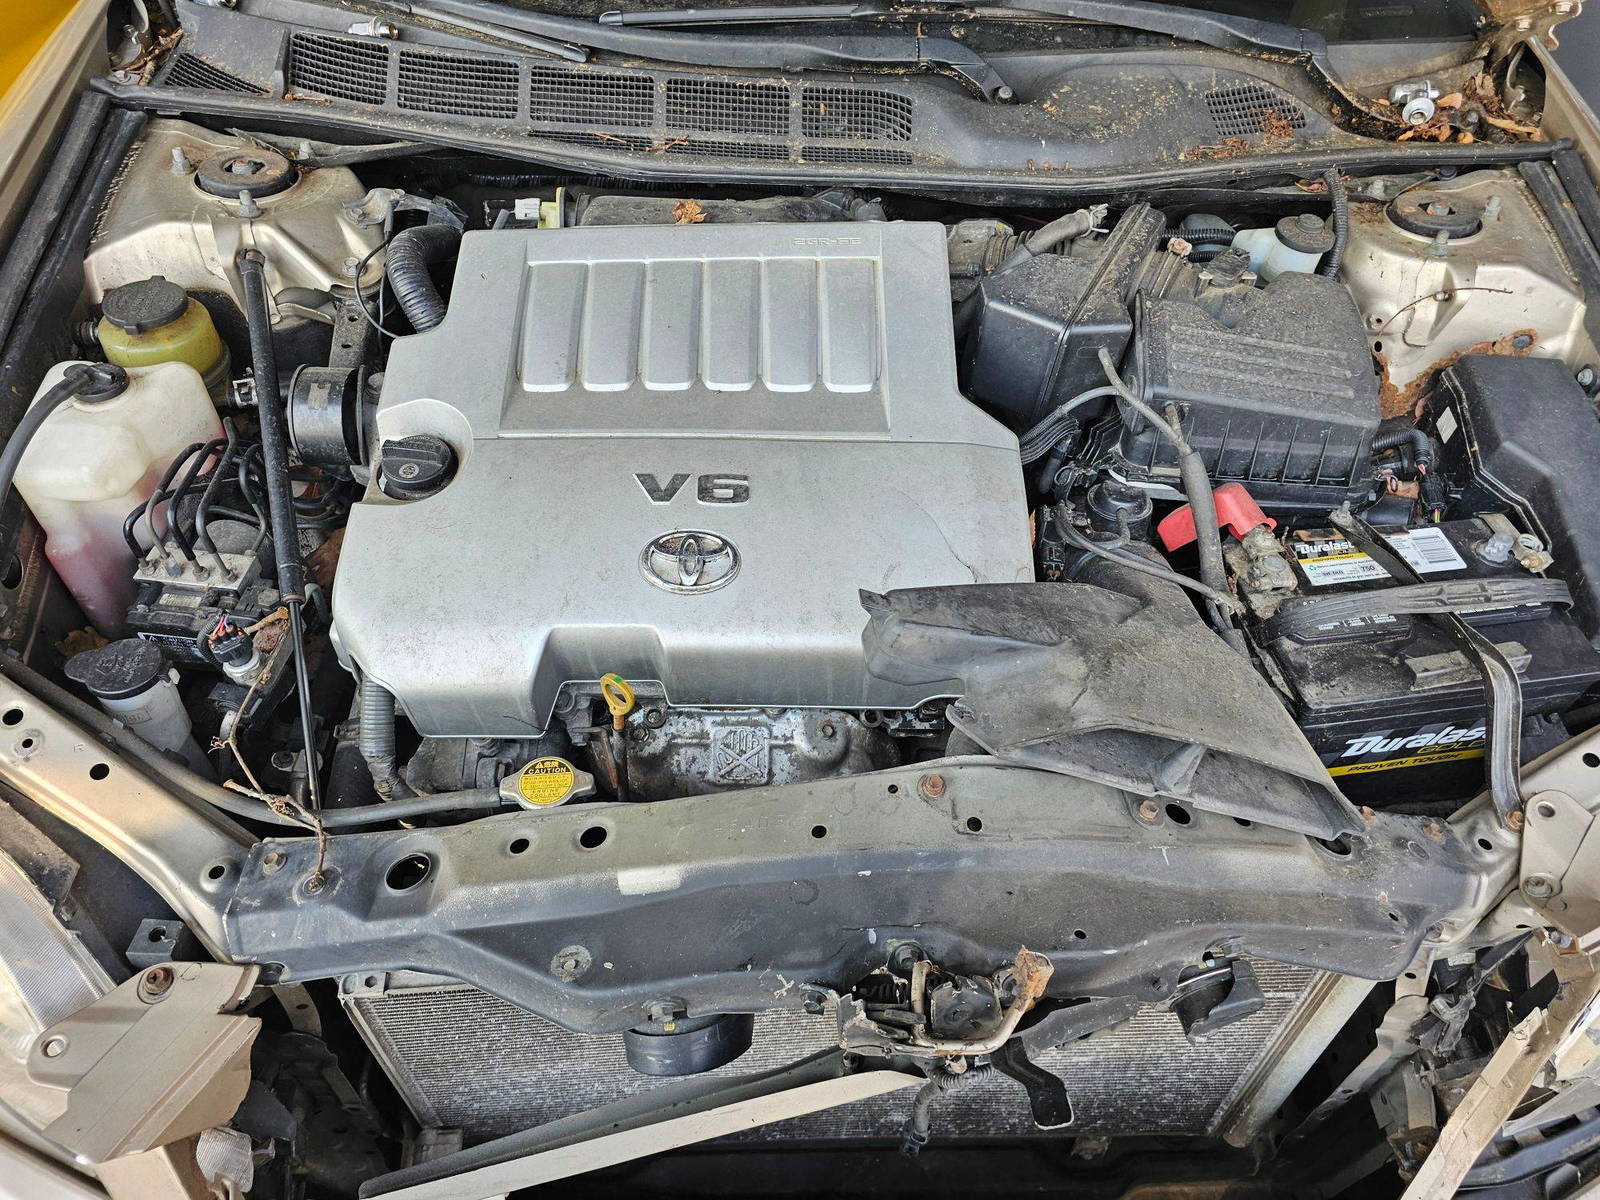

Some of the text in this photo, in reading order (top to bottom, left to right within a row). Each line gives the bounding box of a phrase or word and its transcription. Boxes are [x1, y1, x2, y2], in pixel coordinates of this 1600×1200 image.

[633, 473, 750, 506] V6
[1295, 541, 1355, 554] Duralast
[1360, 565, 1376, 573] 750
[1340, 726, 1486, 758] Duralas
[1347, 753, 1462, 773] PROVEN TOUGH
